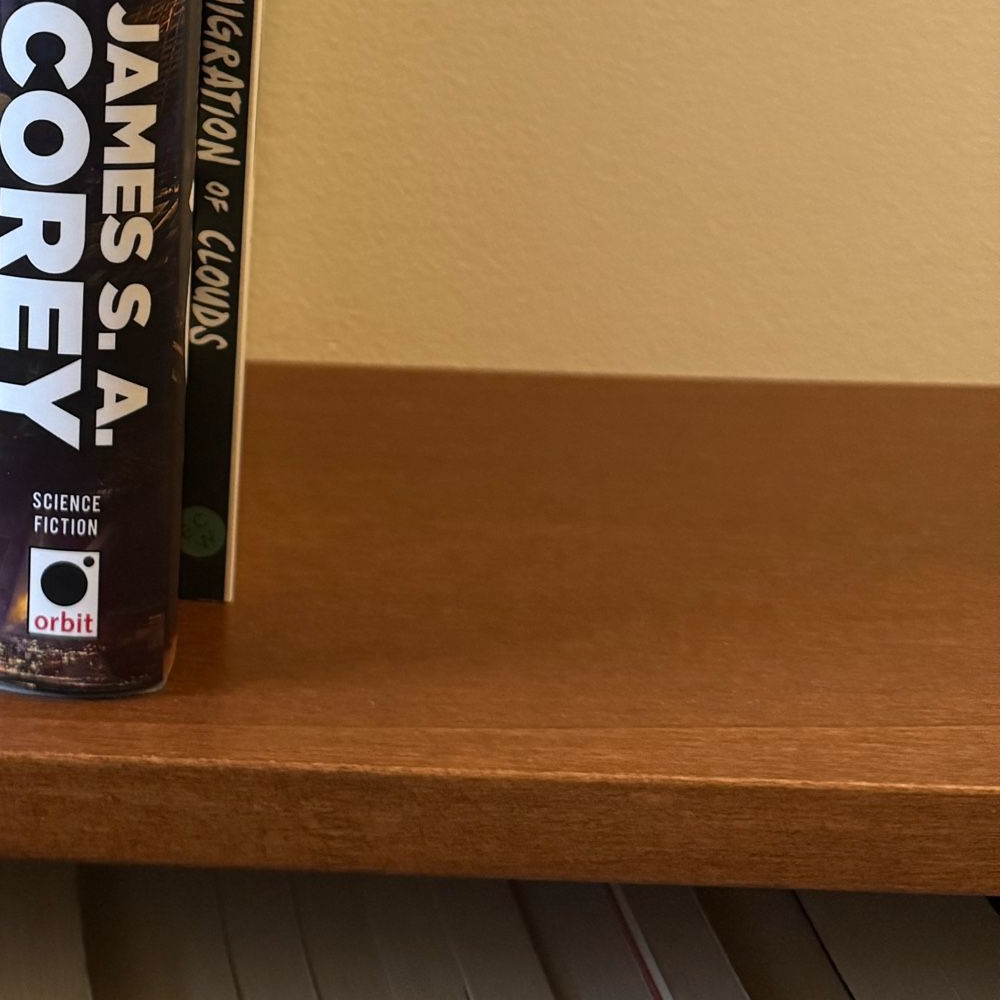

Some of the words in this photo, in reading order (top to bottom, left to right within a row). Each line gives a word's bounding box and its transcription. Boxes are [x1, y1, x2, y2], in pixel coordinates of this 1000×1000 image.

[99, 1, 161, 265] JAMES
[97, 282, 152, 351] S.
[189, 229, 236, 351] CLOUDS
[95, 369, 149, 447] A.
[31, 491, 102, 514] SCIENCE
[33, 515, 99, 537] FICTION
[34, 610, 94, 634] orbit
